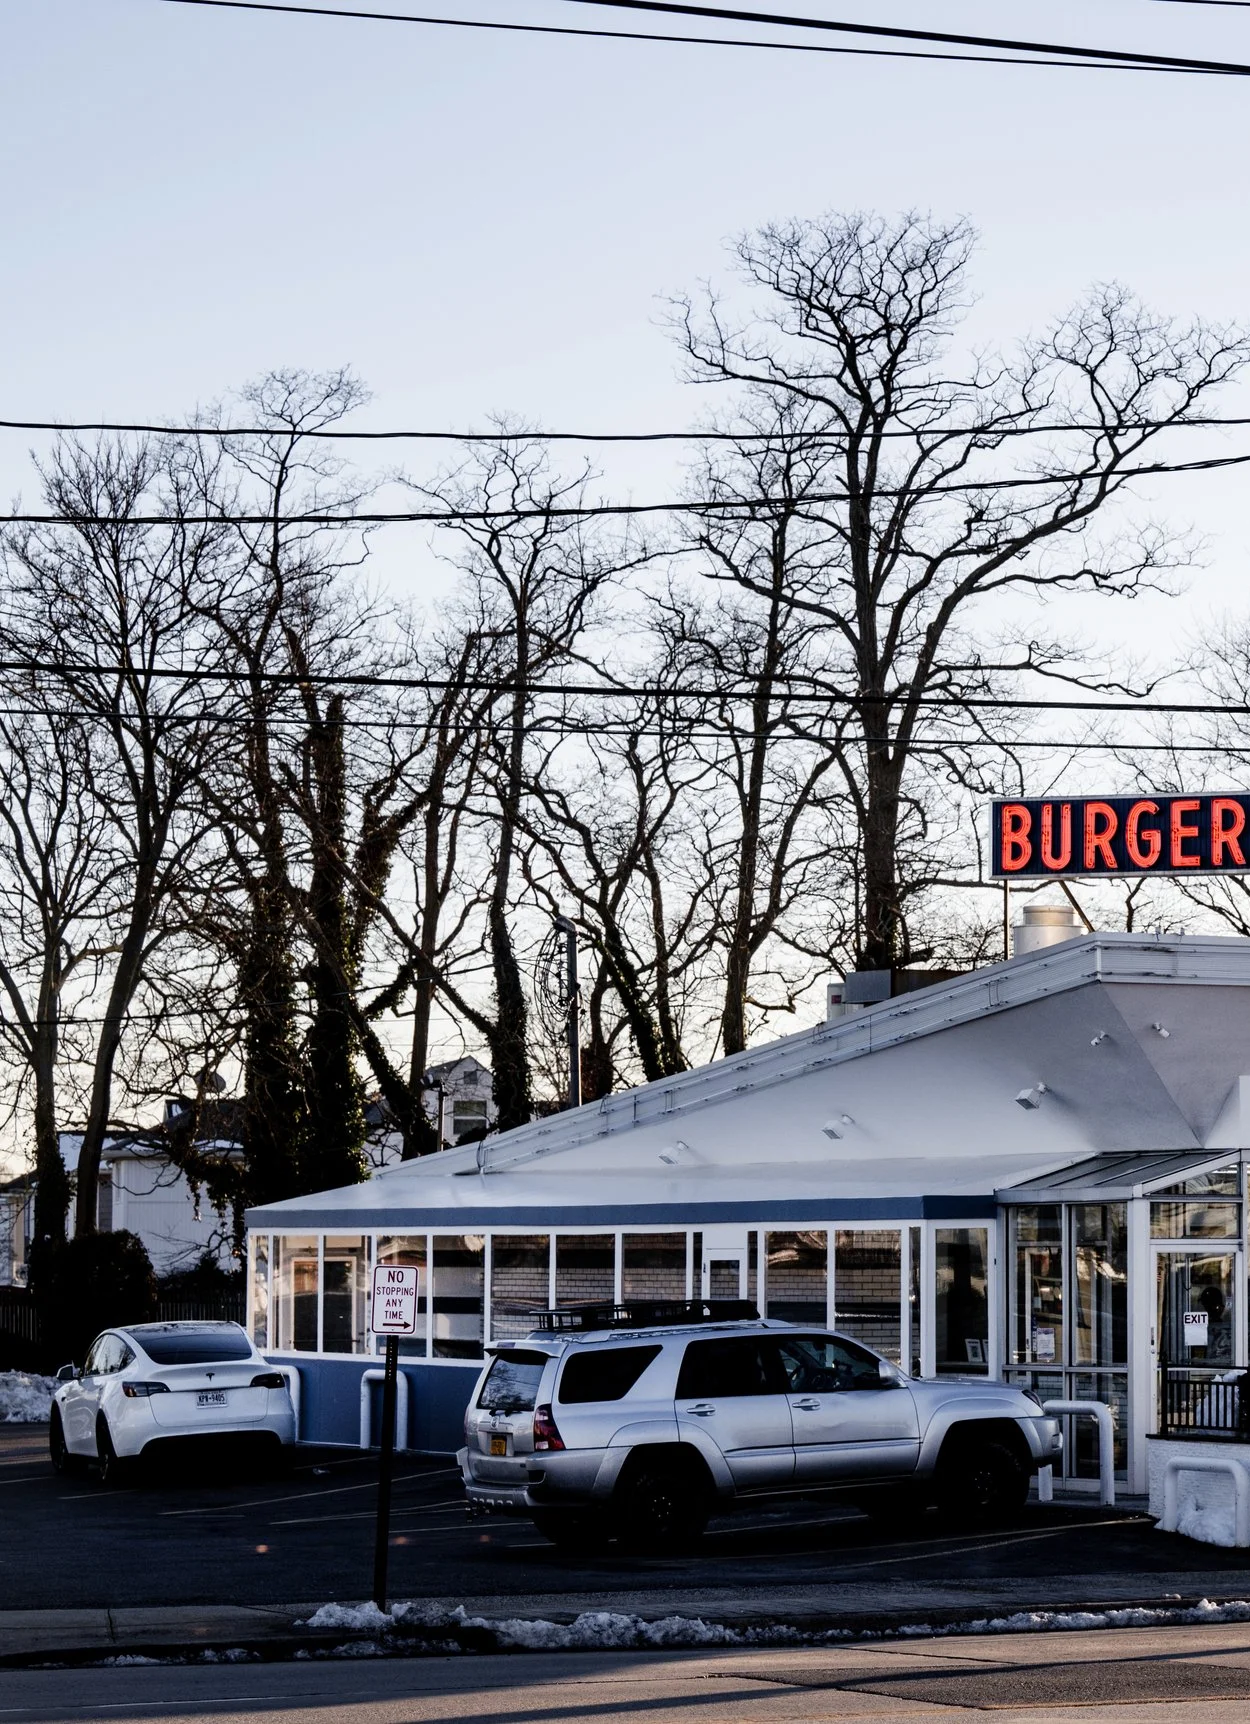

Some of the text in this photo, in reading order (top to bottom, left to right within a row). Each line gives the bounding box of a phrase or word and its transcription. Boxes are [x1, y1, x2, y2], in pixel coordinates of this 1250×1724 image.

[387, 1270, 404, 1283] NO
[376, 1286, 414, 1296] STOPPING
[386, 1299, 403, 1308] ANY
[385, 1310, 403, 1320] TIME
[1184, 1314, 1207, 1324] EXIT
